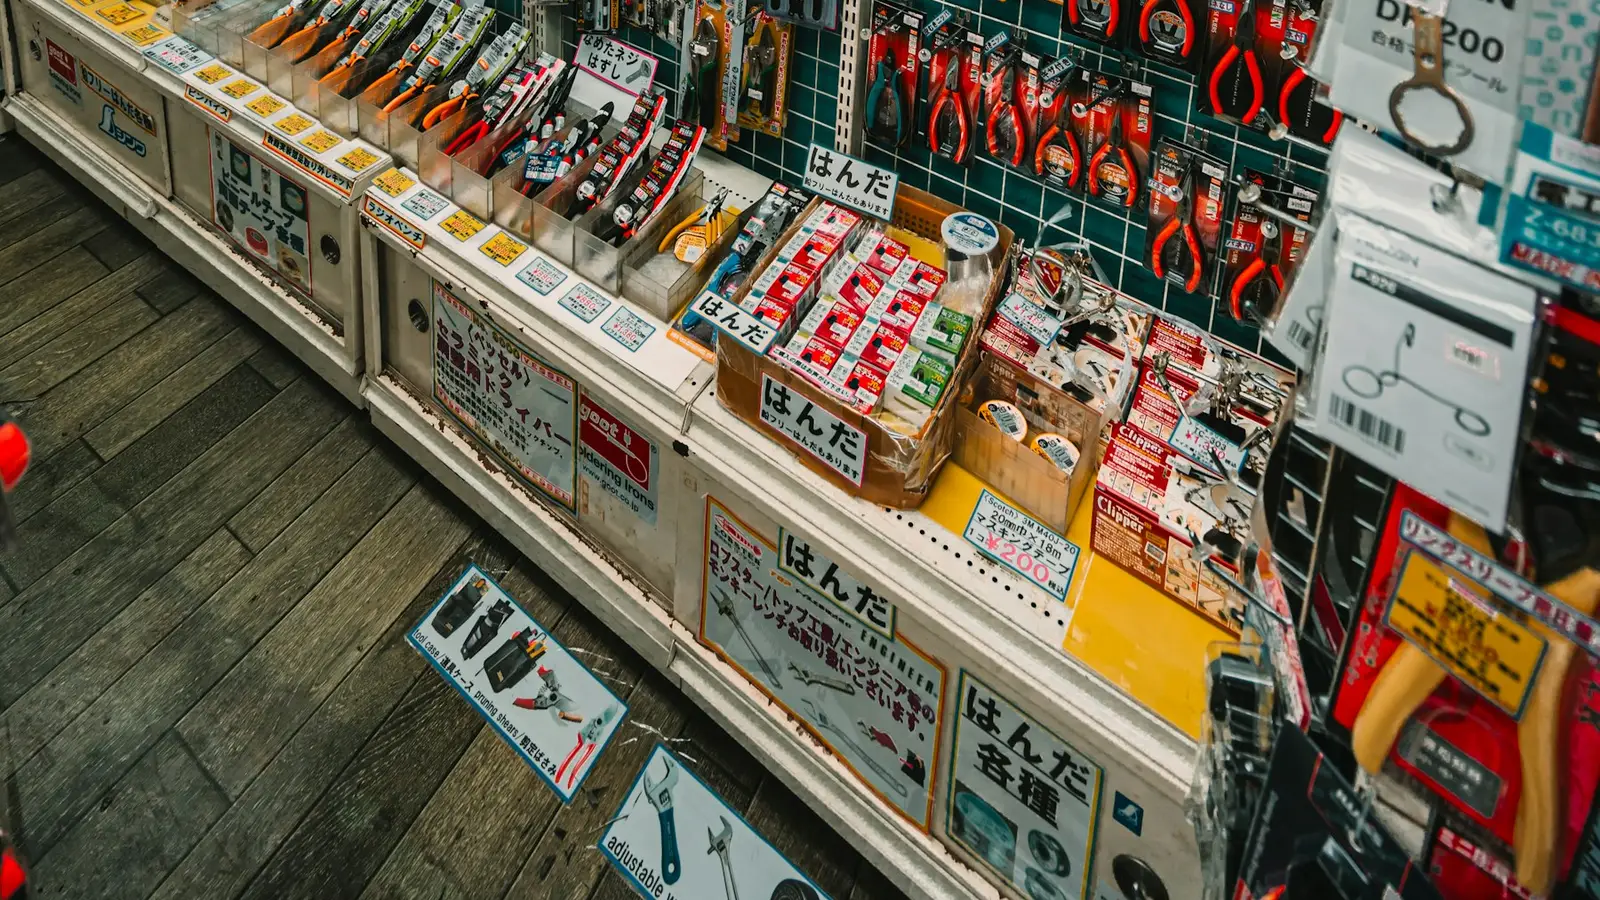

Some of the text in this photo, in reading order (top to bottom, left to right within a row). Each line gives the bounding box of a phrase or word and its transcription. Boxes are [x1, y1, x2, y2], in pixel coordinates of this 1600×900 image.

[584, 34, 640, 65] なめたネジ
[587, 52, 620, 79] はずし
[188, 87, 228, 117] ピンバイス
[222, 168, 295, 228] ビニールテープ
[804, 177, 888, 215] 鉛フリーはんだもあります
[809, 147, 891, 200] はんだ
[368, 200, 422, 241] ラジオペンチ
[435, 284, 471, 318] VESSEL
[521, 353, 573, 391] VESSEL
[698, 295, 769, 346] はんだ
[437, 317, 513, 389] セラミック
[580, 402, 619, 438] goot
[764, 377, 860, 461] はんだ
[1119, 425, 1164, 454] Clipper
[761, 409, 860, 479] 鉛フリーはんだもあります
[524, 466, 571, 504] VESSEL
[579, 445, 655, 511] oldering Irons
[582, 464, 639, 512] www.goot.co.jp
[1021, 517, 1035, 529] 3M
[1097, 495, 1144, 534] Clipper
[1115, 504, 1145, 526] TOOL
[714, 524, 762, 567] LOBSTER
[976, 512, 1071, 575] マスキングテープ
[785, 534, 888, 629] はんだ
[1047, 579, 1065, 596] 税込
[413, 629, 426, 643] tool
[473, 690, 499, 717] pruning
[966, 685, 1091, 801] はんだ
[974, 742, 1061, 830] 各種
[607, 835, 664, 900] adjustable
